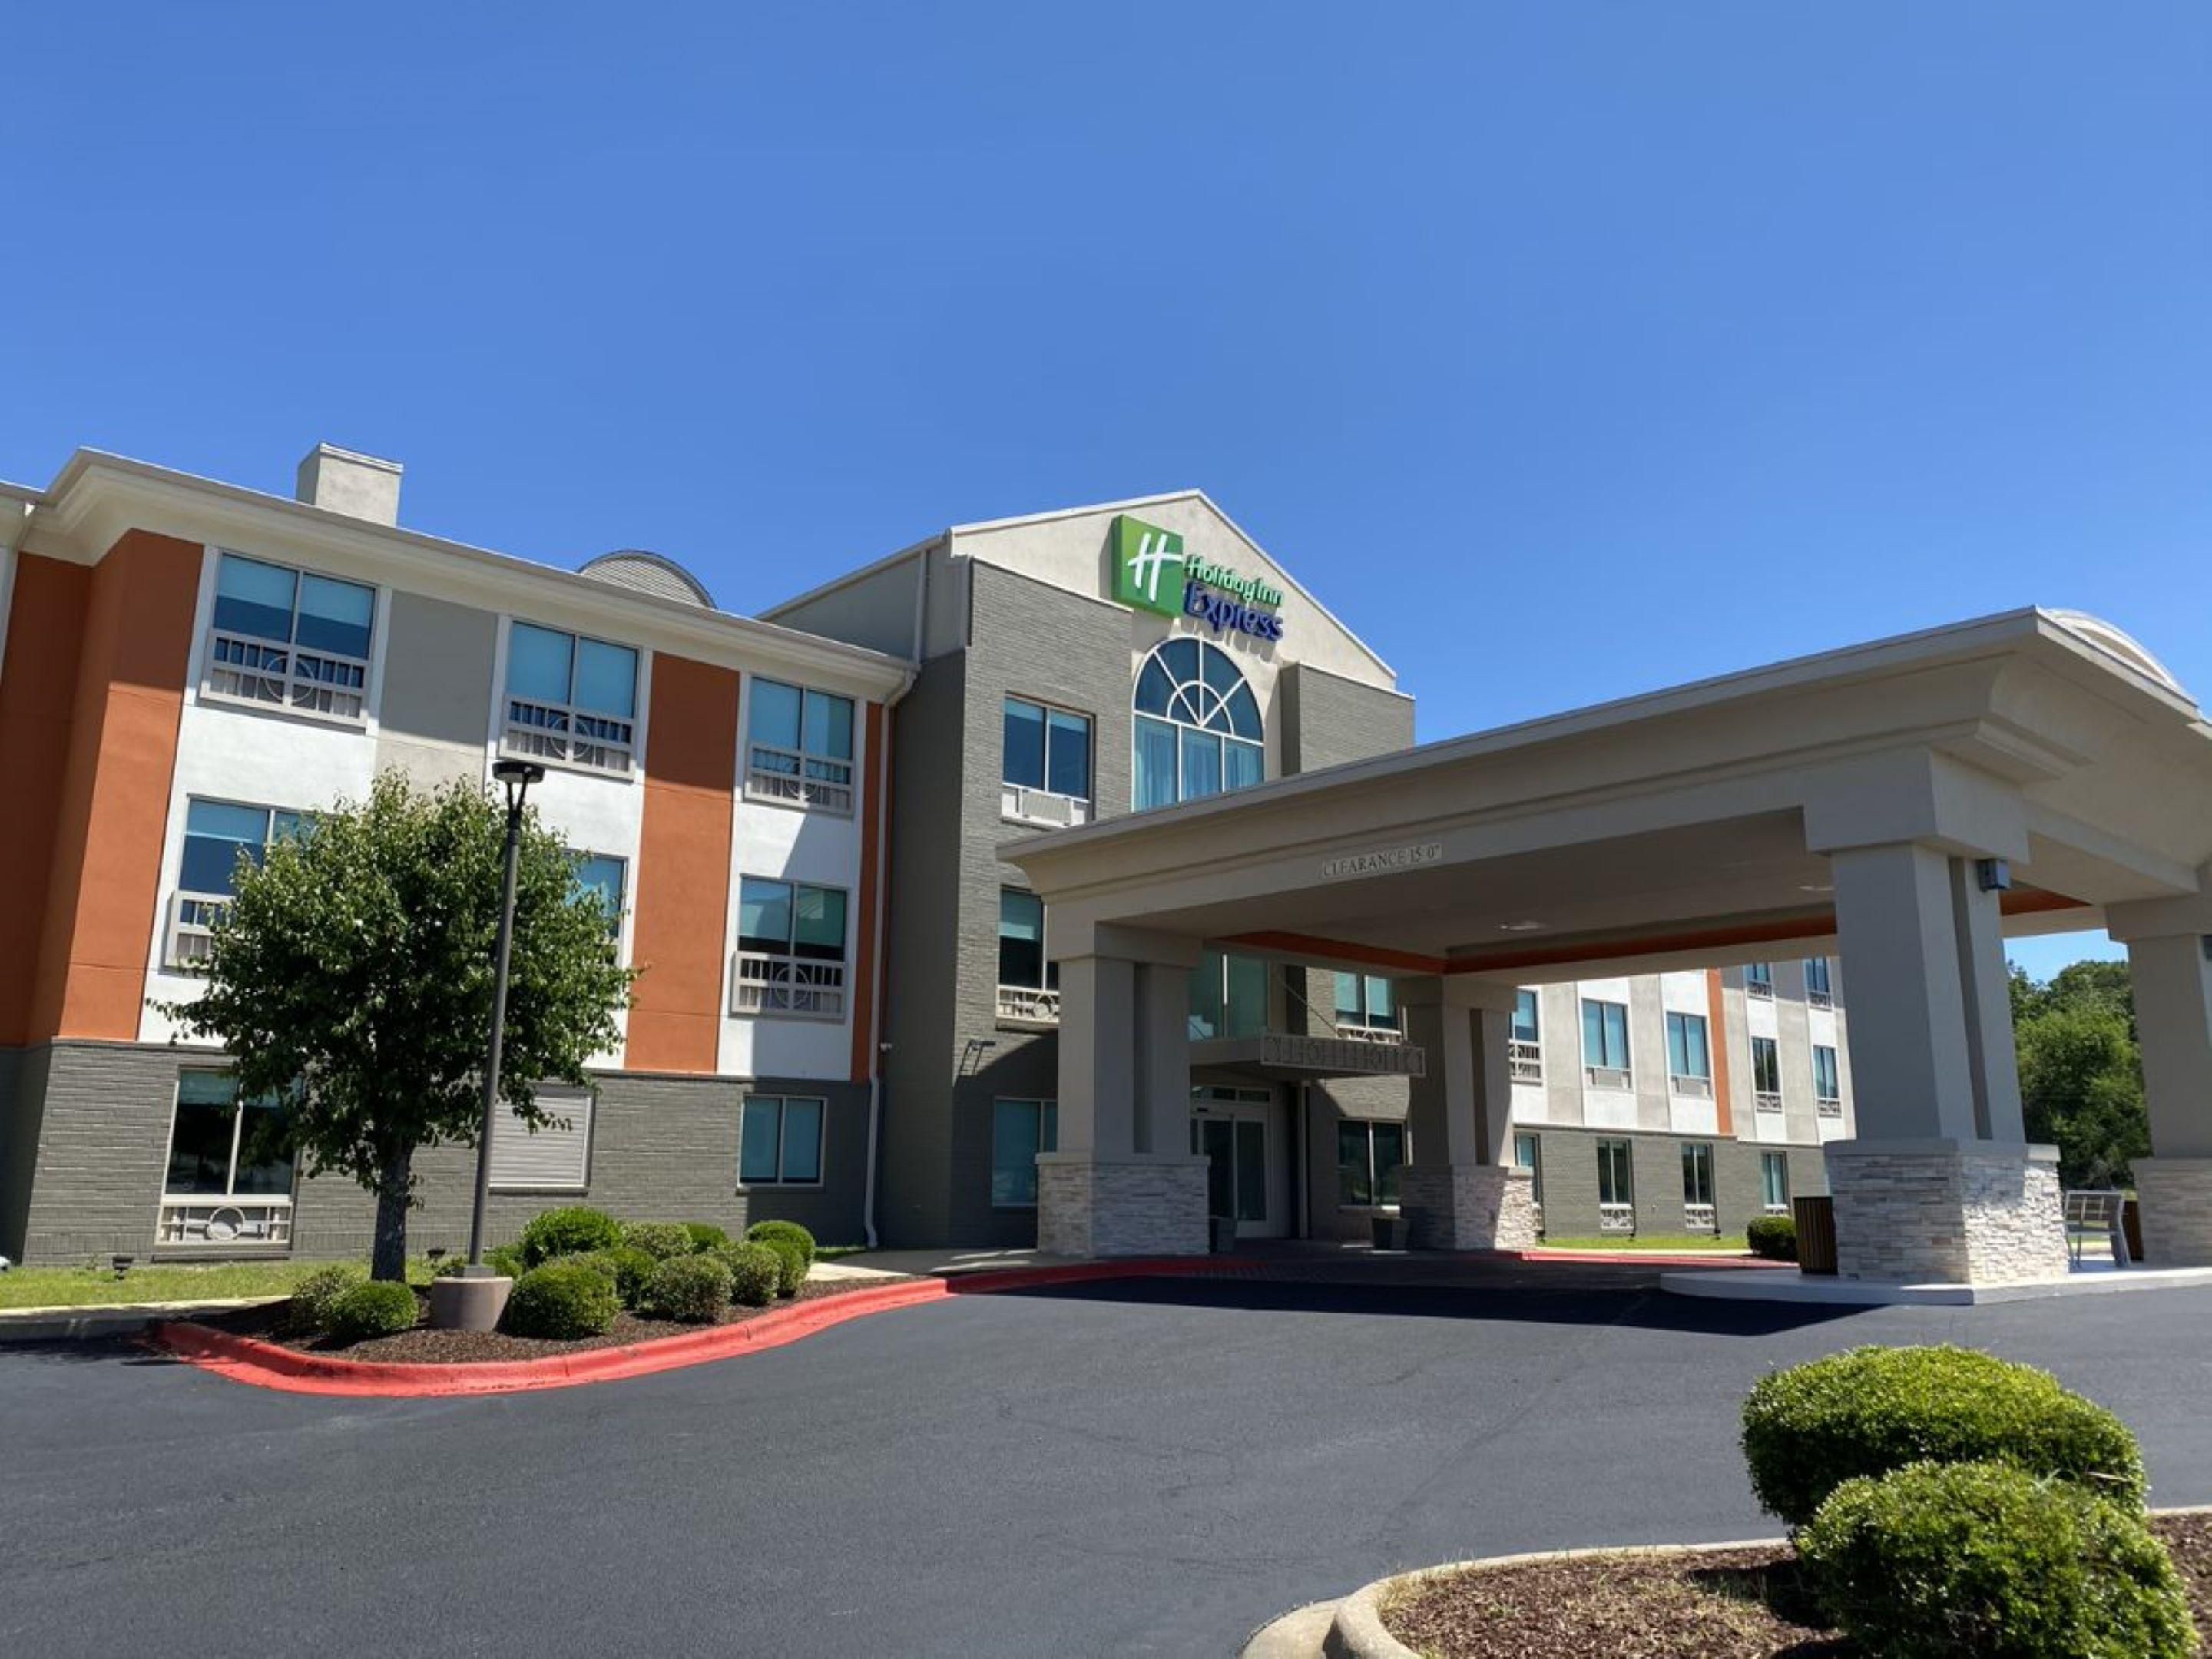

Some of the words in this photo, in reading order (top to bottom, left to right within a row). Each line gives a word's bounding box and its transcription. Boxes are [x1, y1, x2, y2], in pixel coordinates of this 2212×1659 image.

[1187, 555, 1253, 601] Holiday
[1253, 578, 1284, 606] Inn
[1185, 582, 1283, 641] Express
[1323, 851, 1406, 876] CLEARANCE
